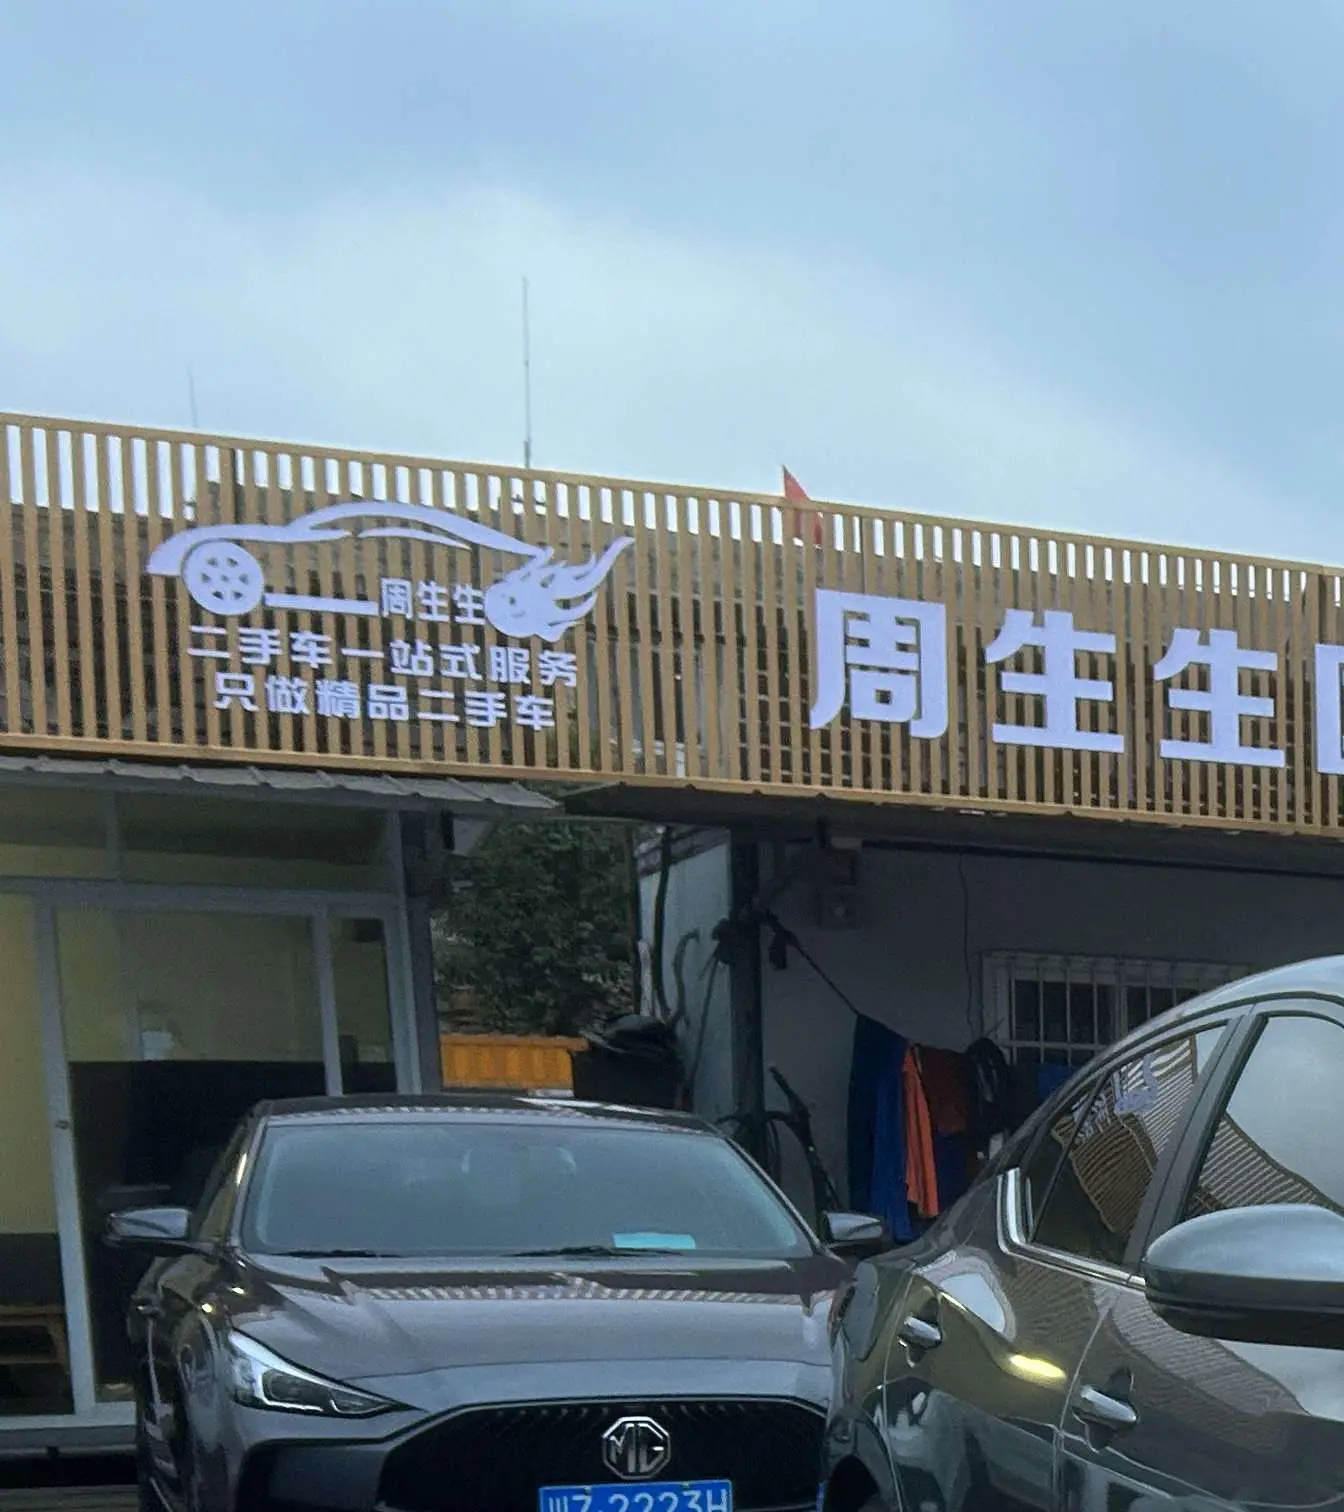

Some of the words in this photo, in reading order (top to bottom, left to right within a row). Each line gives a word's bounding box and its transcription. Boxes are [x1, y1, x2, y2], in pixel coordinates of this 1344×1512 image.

[380, 577, 486, 625] 周生生
[187, 624, 579, 688] 二手车一站式服务
[213, 672, 556, 732] 只做精品二手车
[608, 1422, 665, 1474] MG
